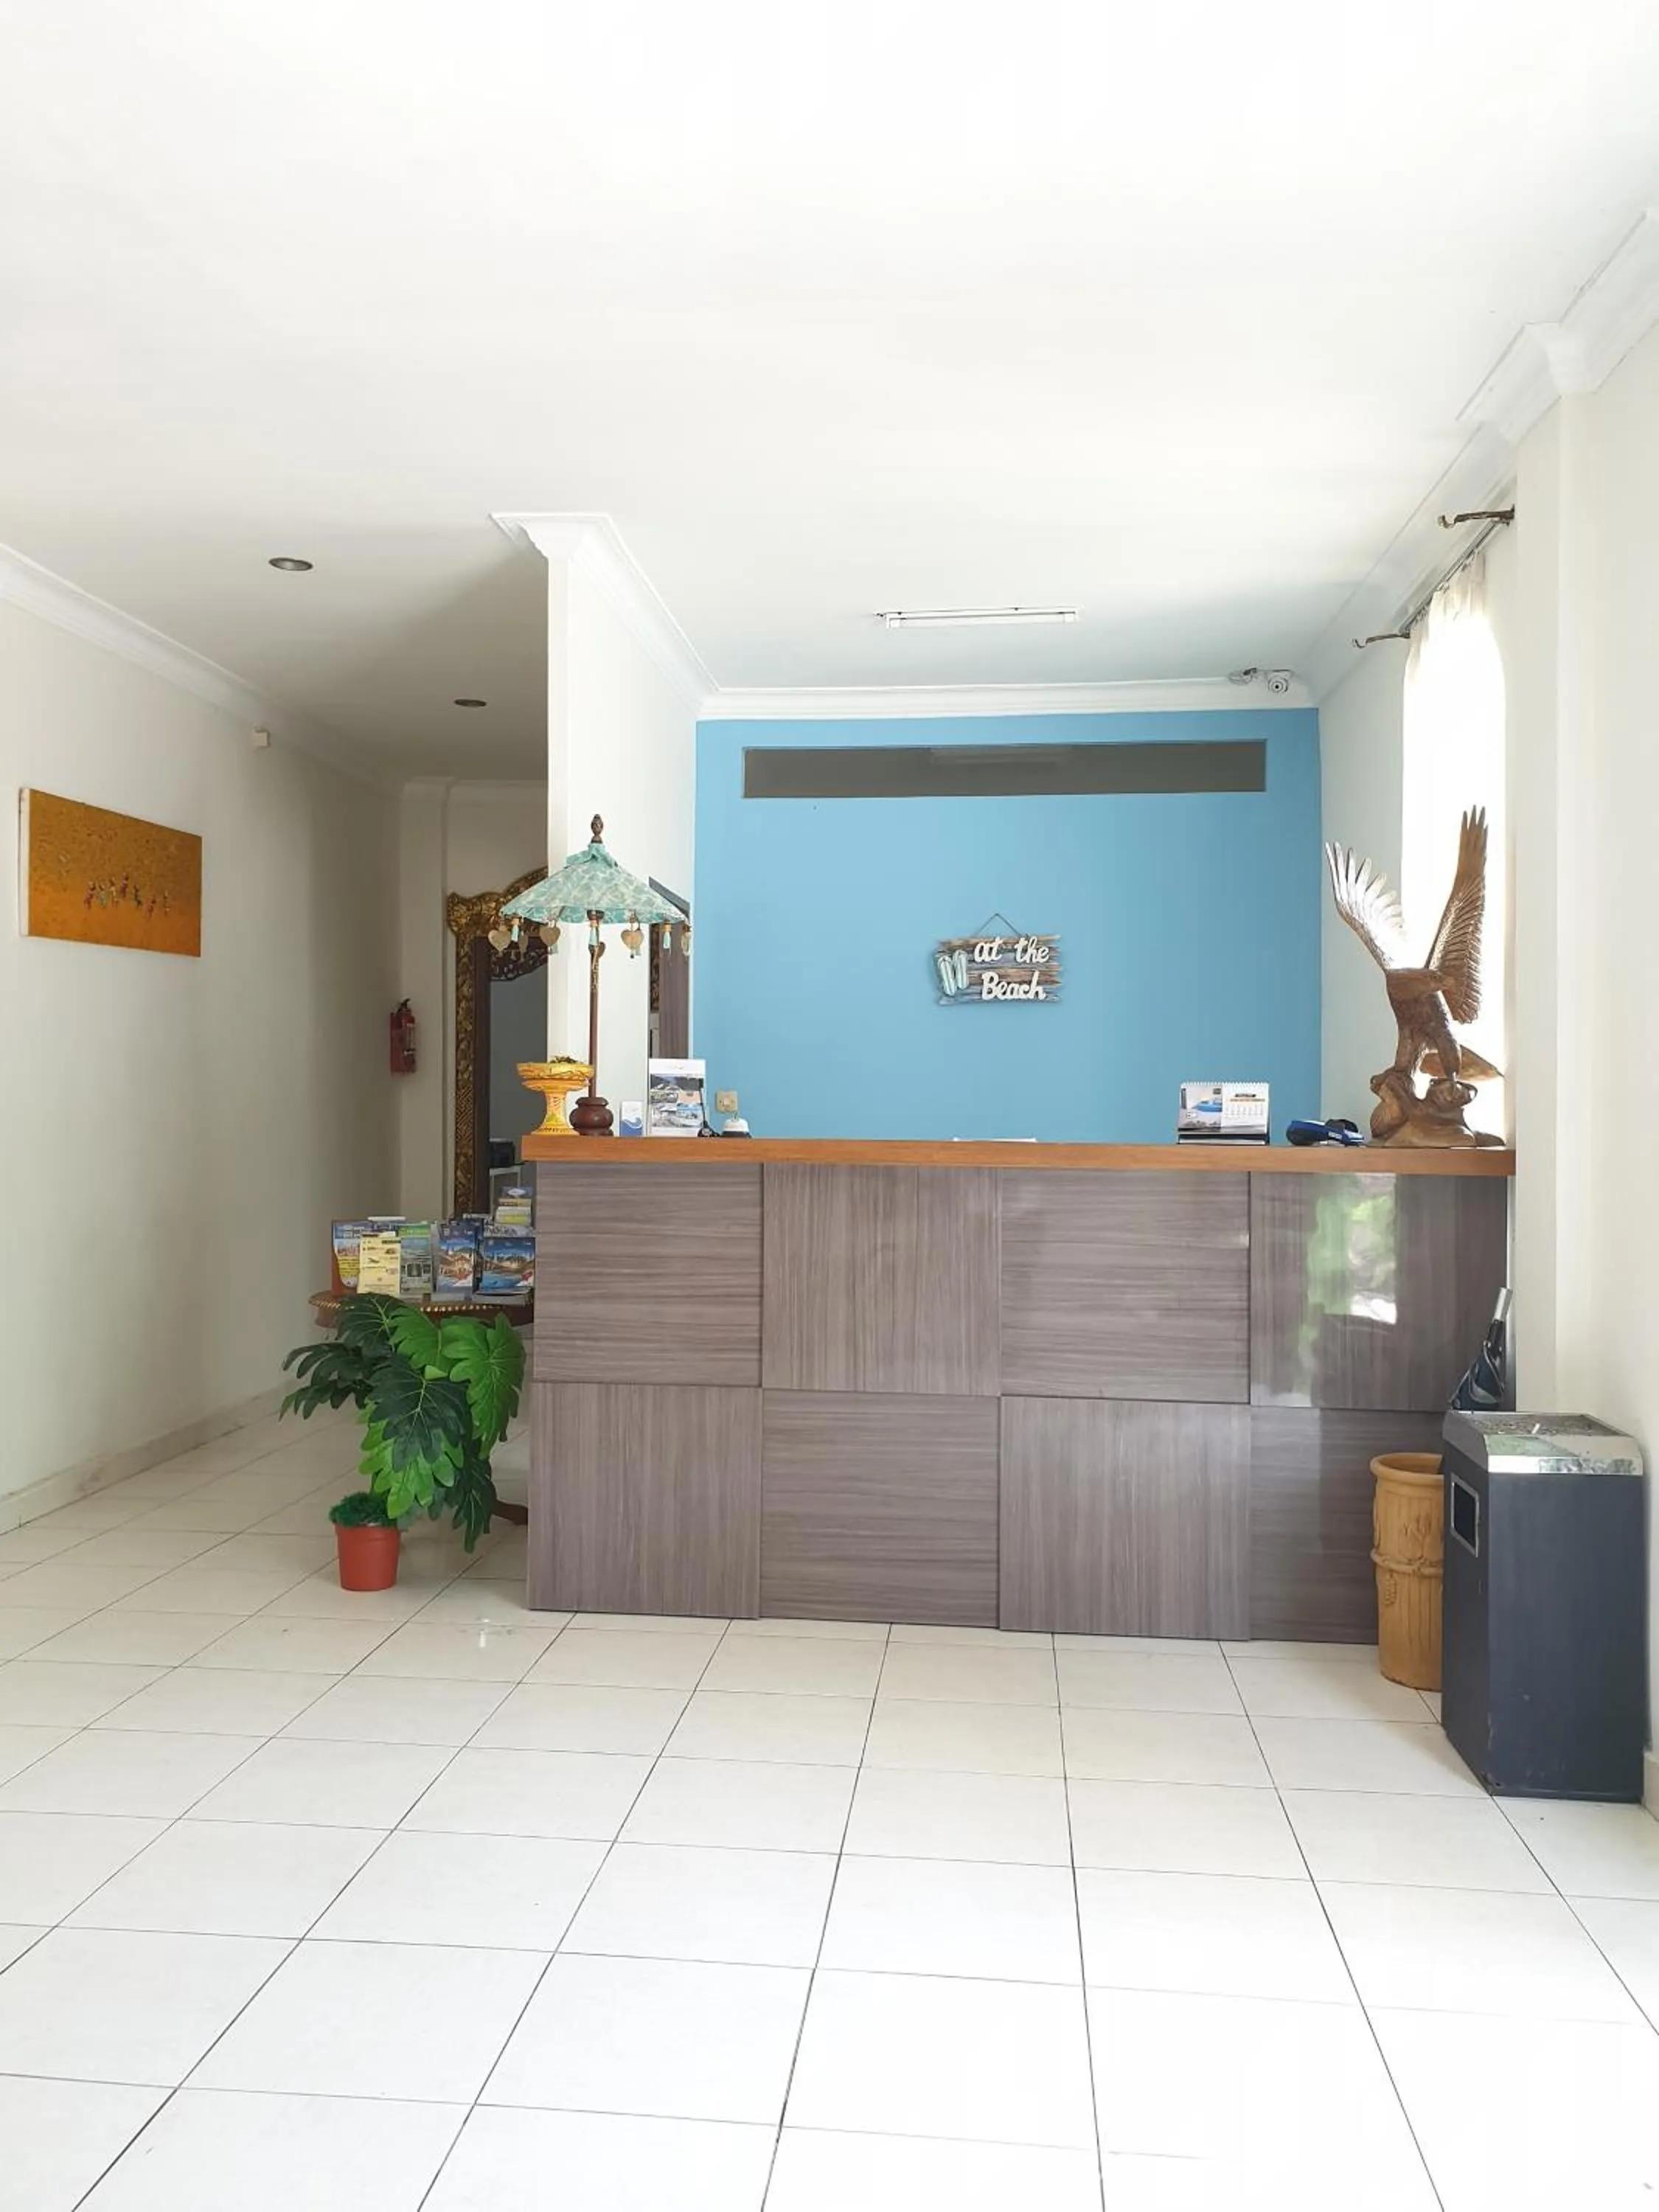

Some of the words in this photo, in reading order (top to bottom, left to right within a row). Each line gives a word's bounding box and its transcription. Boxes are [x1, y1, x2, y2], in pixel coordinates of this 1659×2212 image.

[974, 936, 1004, 963] at
[1014, 936, 1049, 963] the
[981, 970, 1046, 1001] Beach
